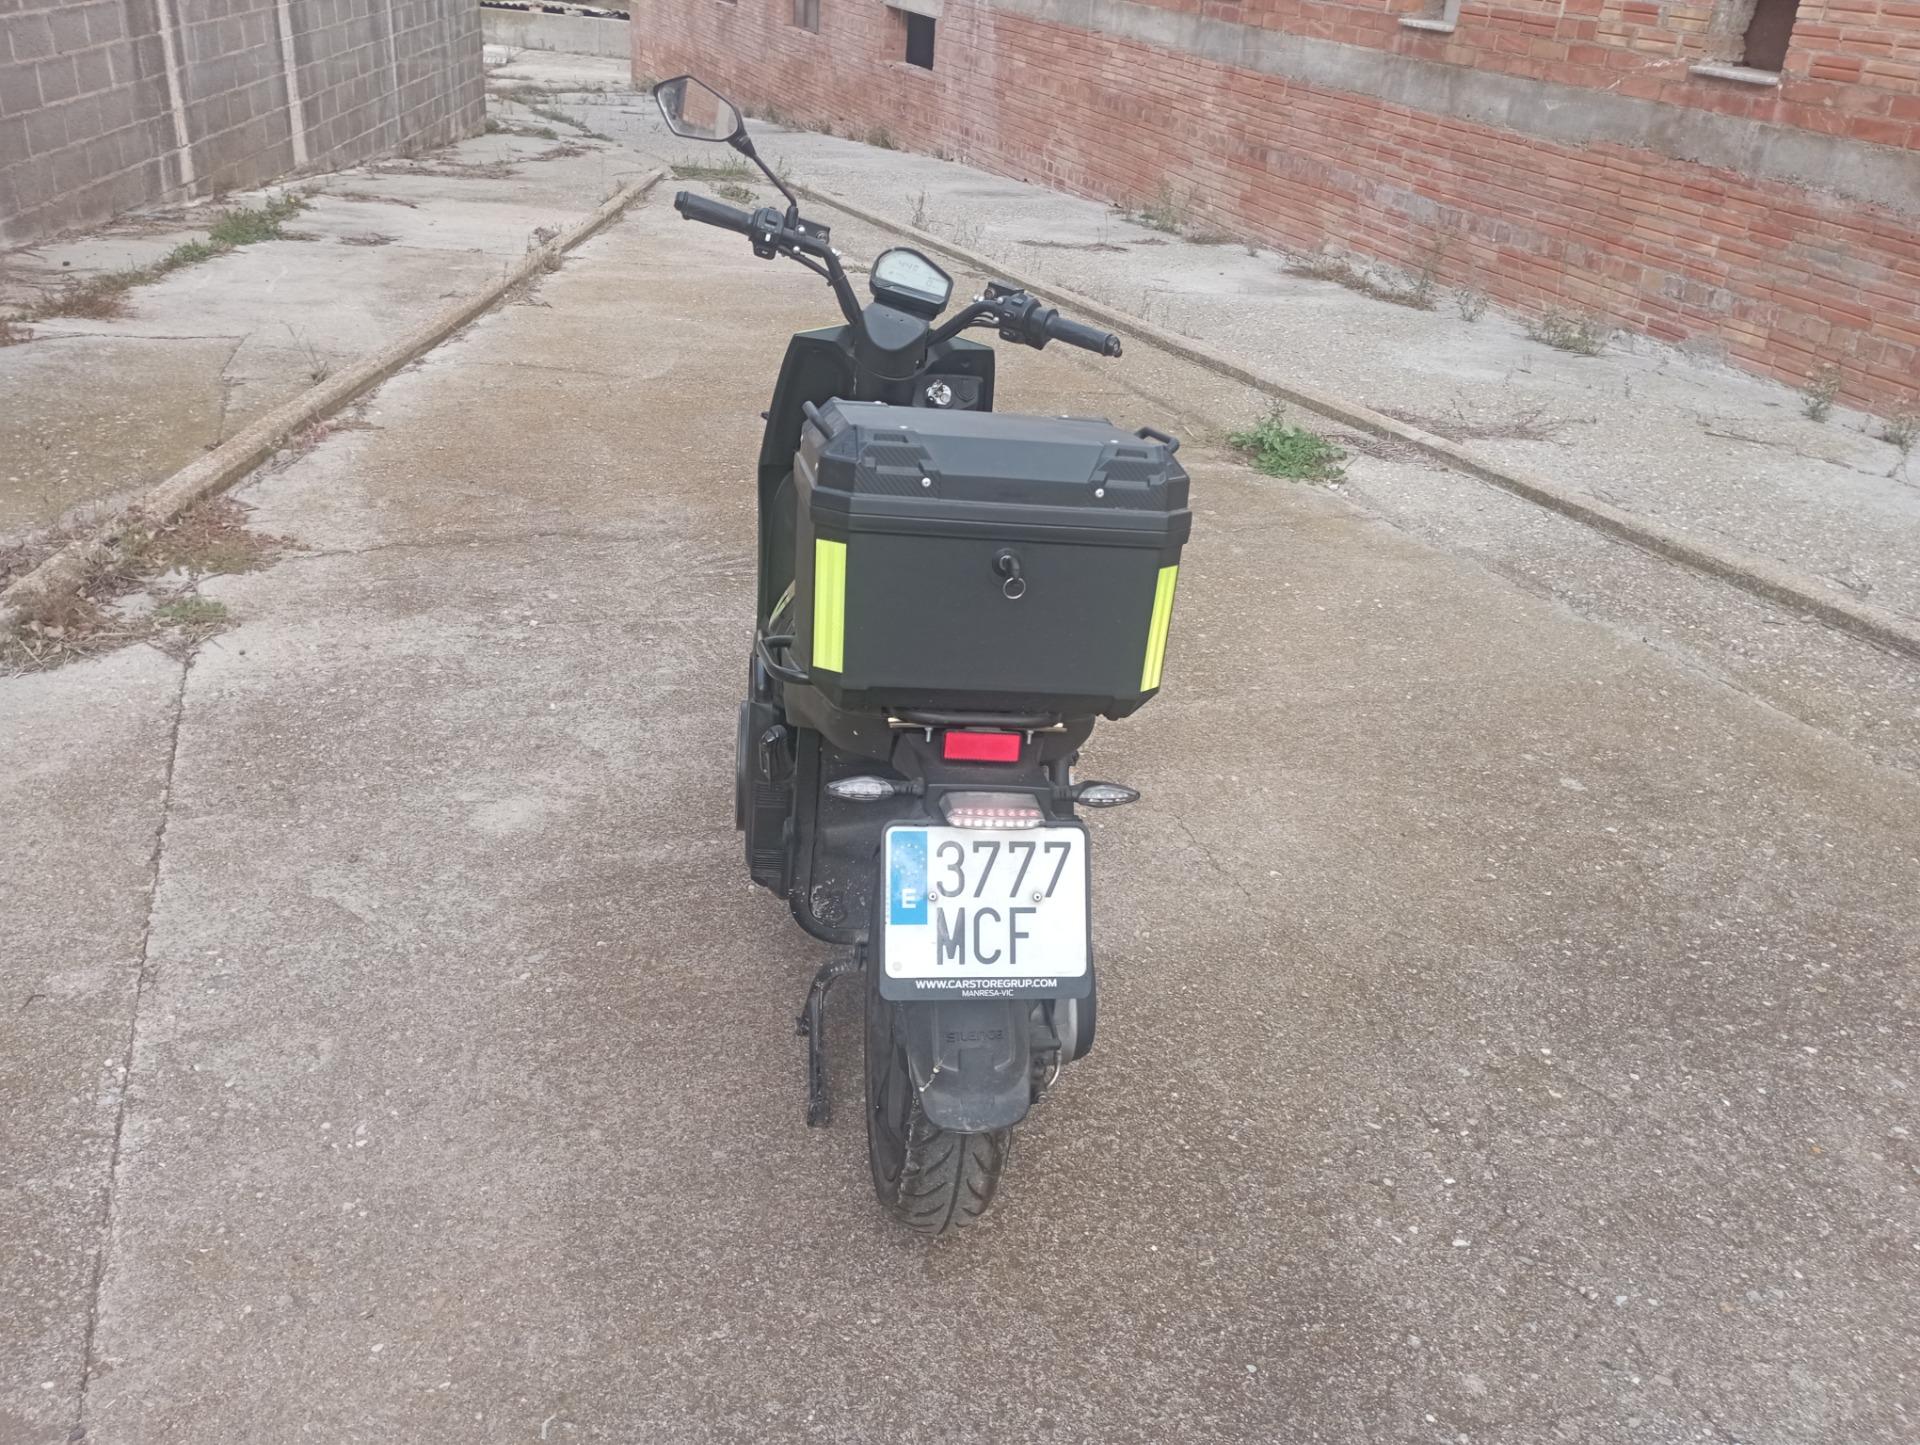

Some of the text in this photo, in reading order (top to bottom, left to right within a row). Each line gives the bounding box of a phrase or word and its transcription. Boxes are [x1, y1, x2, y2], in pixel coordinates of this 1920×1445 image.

[936, 840, 1072, 898] 3777
[901, 888, 916, 909] E
[937, 907, 1037, 965] MCF
[915, 978, 1057, 989] WWW.CARSTOREGRUP.COM
[961, 989, 1014, 997] MANRESA-VIC
